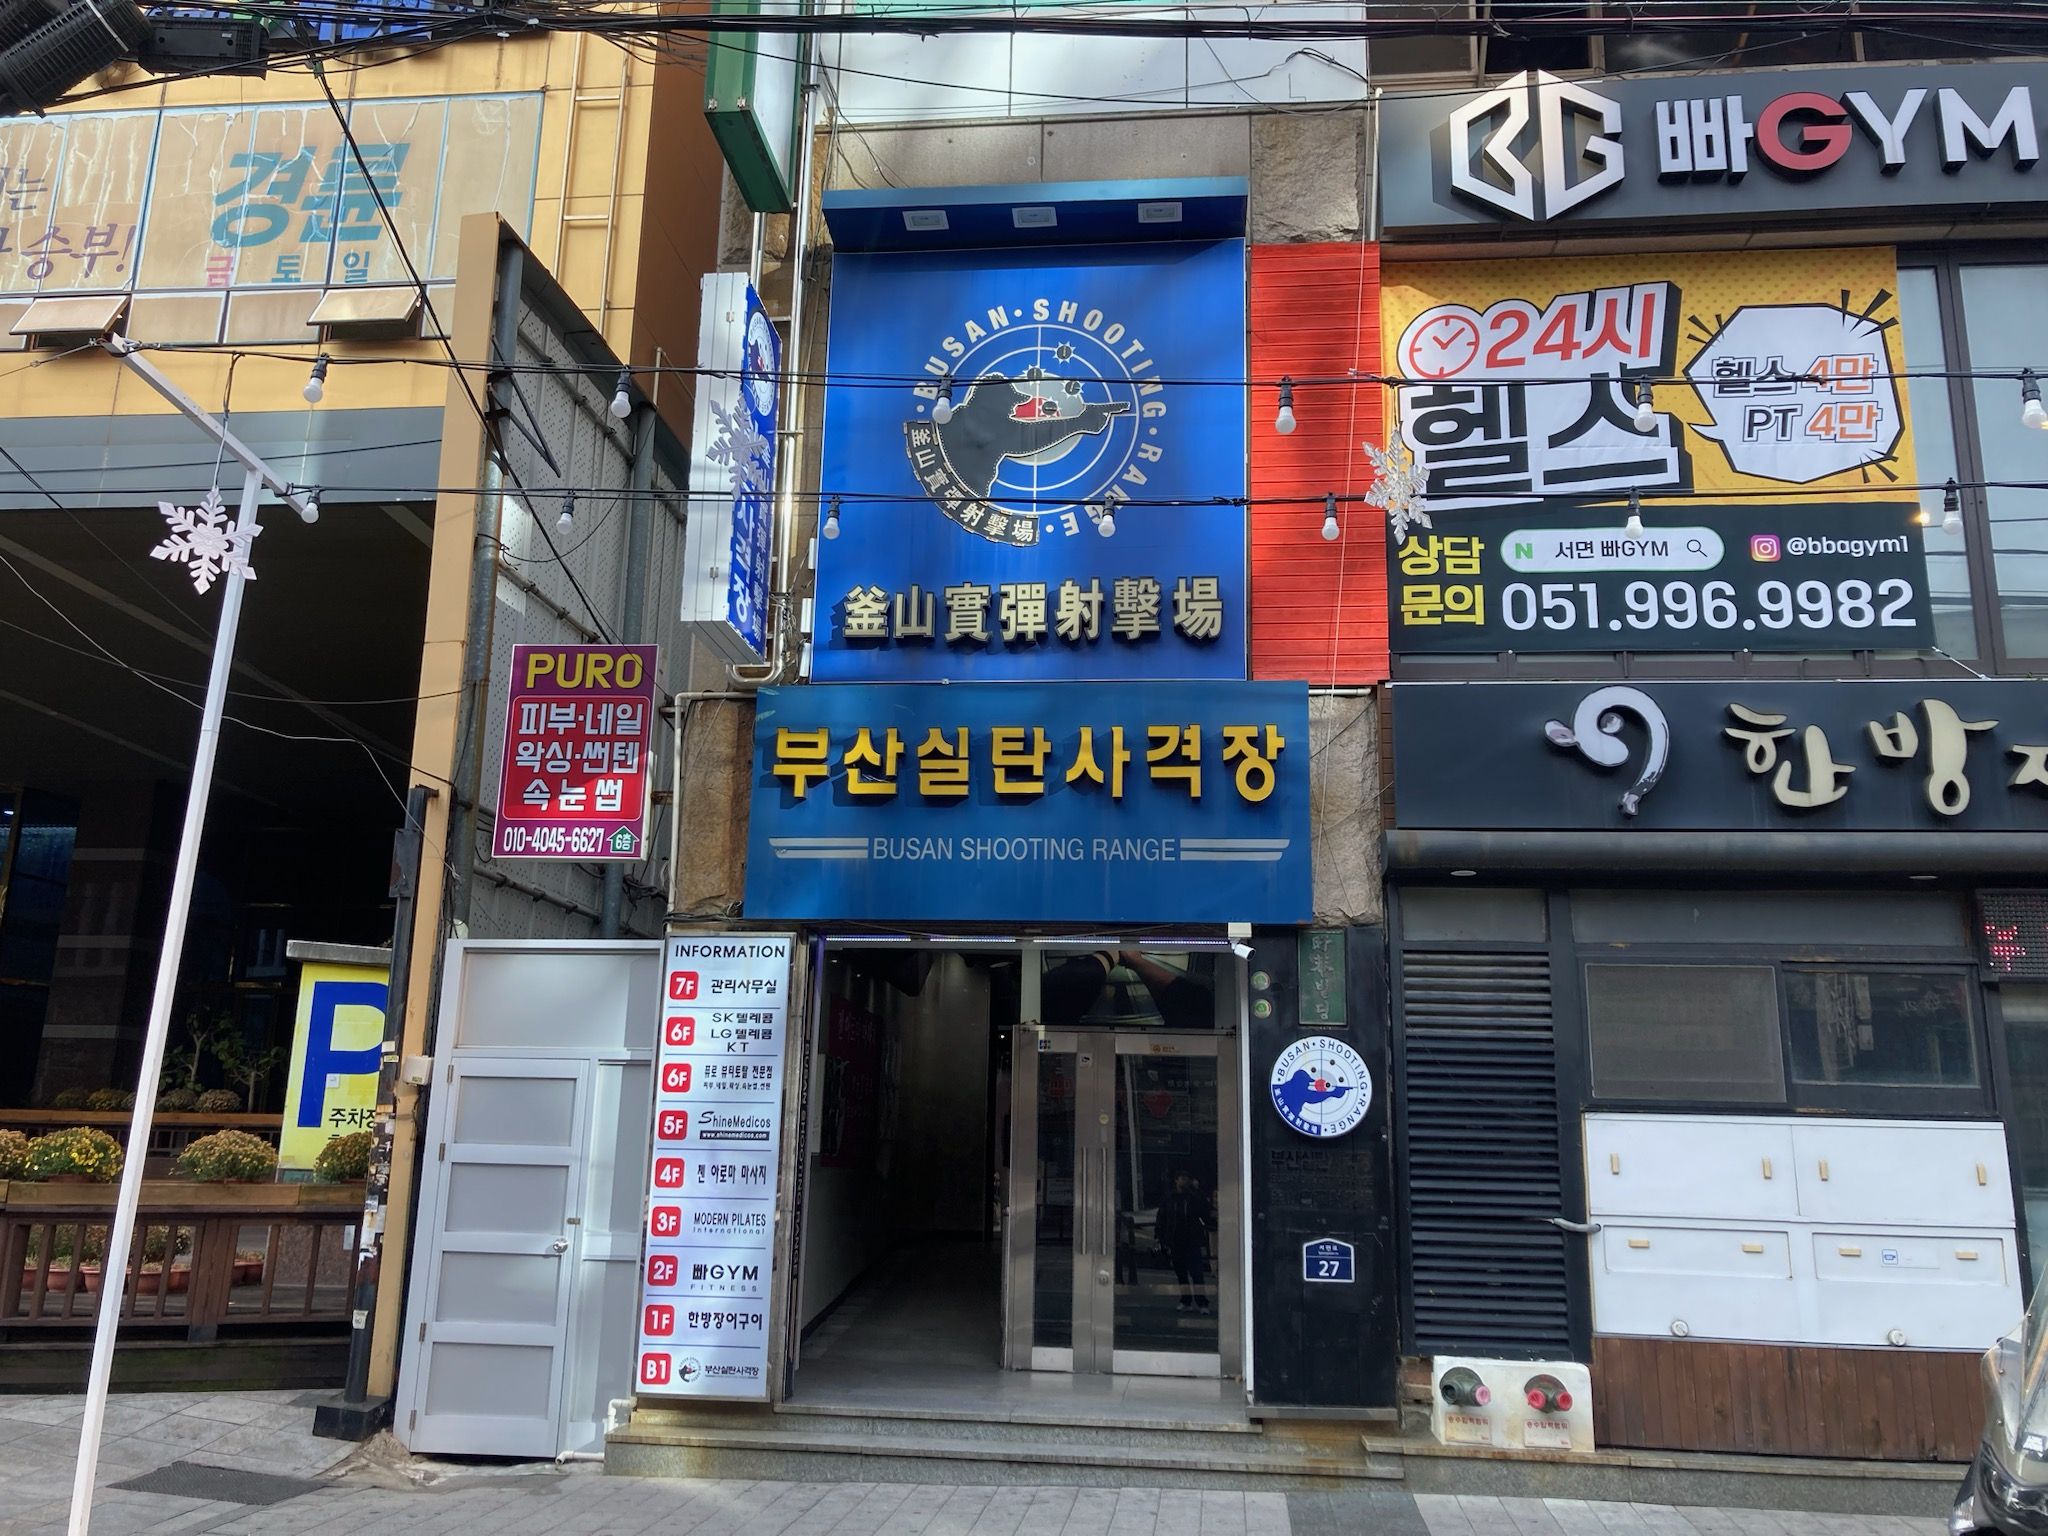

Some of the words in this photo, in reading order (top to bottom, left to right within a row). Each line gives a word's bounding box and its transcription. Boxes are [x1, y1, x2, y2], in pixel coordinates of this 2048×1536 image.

[1656, 86, 2039, 184] 빠GYM
[209, 142, 410, 248] 경륜
[206, 256, 233, 287] 금
[272, 255, 301, 283] 토
[343, 251, 370, 283] 일
[1485, 294, 1654, 369] 24시
[913, 305, 1009, 400] BUSAN
[1033, 299, 1166, 418] SHOOTING
[1713, 356, 1796, 397] 헬스
[1801, 355, 1878, 395] 4만
[1410, 372, 1668, 492] 헬스
[1742, 405, 1801, 441] PT
[1808, 402, 1882, 441] 4만
[1399, 536, 1484, 576] 상담
[1555, 539, 1595, 560] 서면
[1601, 538, 1669, 560] 빠GYM
[1787, 534, 1909, 562] @bbagym1
[842, 575, 1224, 642] 釜山實彈射擊場
[1400, 583, 1484, 626] 문의
[1501, 578, 1916, 632] 051.996.9982
[526, 653, 643, 689] PURO
[772, 723, 1285, 803] 부산실탄사격장
[503, 826, 604, 853] 010-4045-6627
[615, 833, 631, 850] 6층
[873, 838, 954, 861] BUSAN
[961, 837, 1084, 862] SHOOTING
[1092, 838, 1176, 861] RANGE
[675, 945, 785, 958] INFORMATION
[675, 978, 695, 995] 7F
[711, 979, 777, 994] 관리사무실
[671, 1024, 691, 1040] 6F
[711, 1029, 732, 1038] LG
[712, 1013, 734, 1023] SK
[736, 1012, 773, 1024] 텔레콤
[297, 981, 388, 1127] P
[1277, 1041, 1311, 1076] BUSAN
[1319, 1039, 1368, 1090] SHOOTING
[667, 1069, 687, 1087] 6F
[664, 1116, 684, 1134] 5F
[698, 1111, 771, 1128] ShineMedicos
[1331, 1099, 1367, 1134] RANGE
[660, 1165, 680, 1183] 4F
[741, 1165, 767, 1185] 마사지
[656, 1213, 677, 1232] 3F
[694, 1213, 729, 1226] MODERN
[731, 1213, 766, 1227] PILATES
[653, 1261, 674, 1280] 2F
[692, 1264, 758, 1281] 빠GYM
[1319, 1261, 1340, 1276] 27
[690, 1284, 757, 1292] FITNESS
[652, 1311, 670, 1329] 1F
[688, 1311, 763, 1330] 한방장어구이
[646, 1361, 666, 1379] B1
